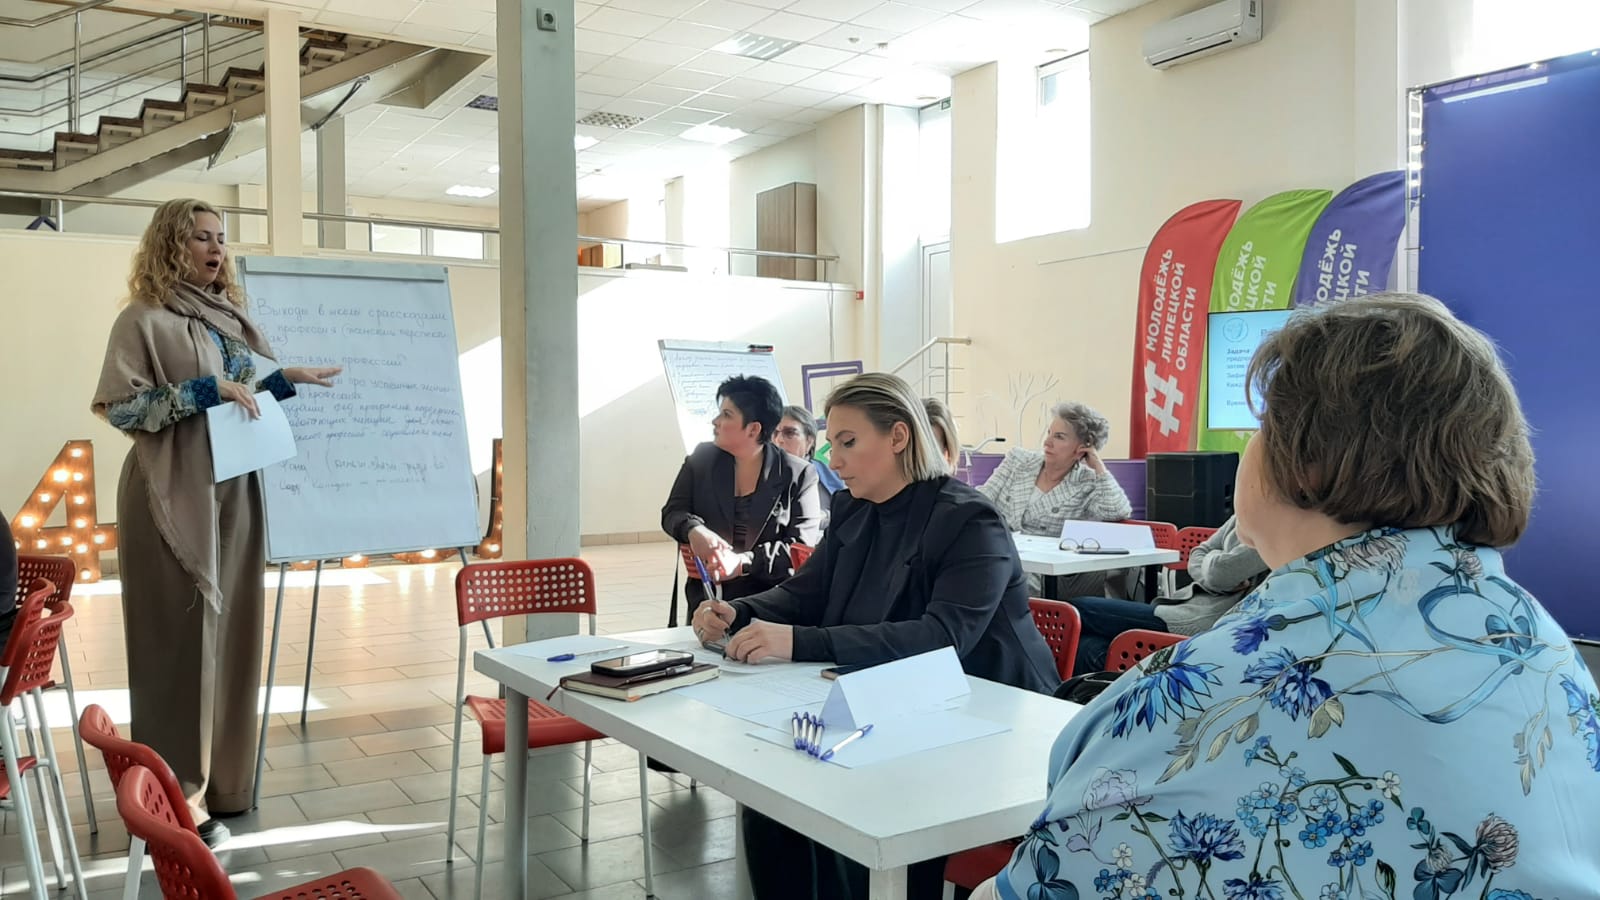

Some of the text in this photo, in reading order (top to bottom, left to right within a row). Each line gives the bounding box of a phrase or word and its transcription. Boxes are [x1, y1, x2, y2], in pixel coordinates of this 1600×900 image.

[1145, 249, 1174, 352] МОЛОДЁЖЬ
[1161, 262, 1185, 363] ЛИПЕЦКОЙ
[1176, 287, 1197, 371] ОБЛАСТИ
